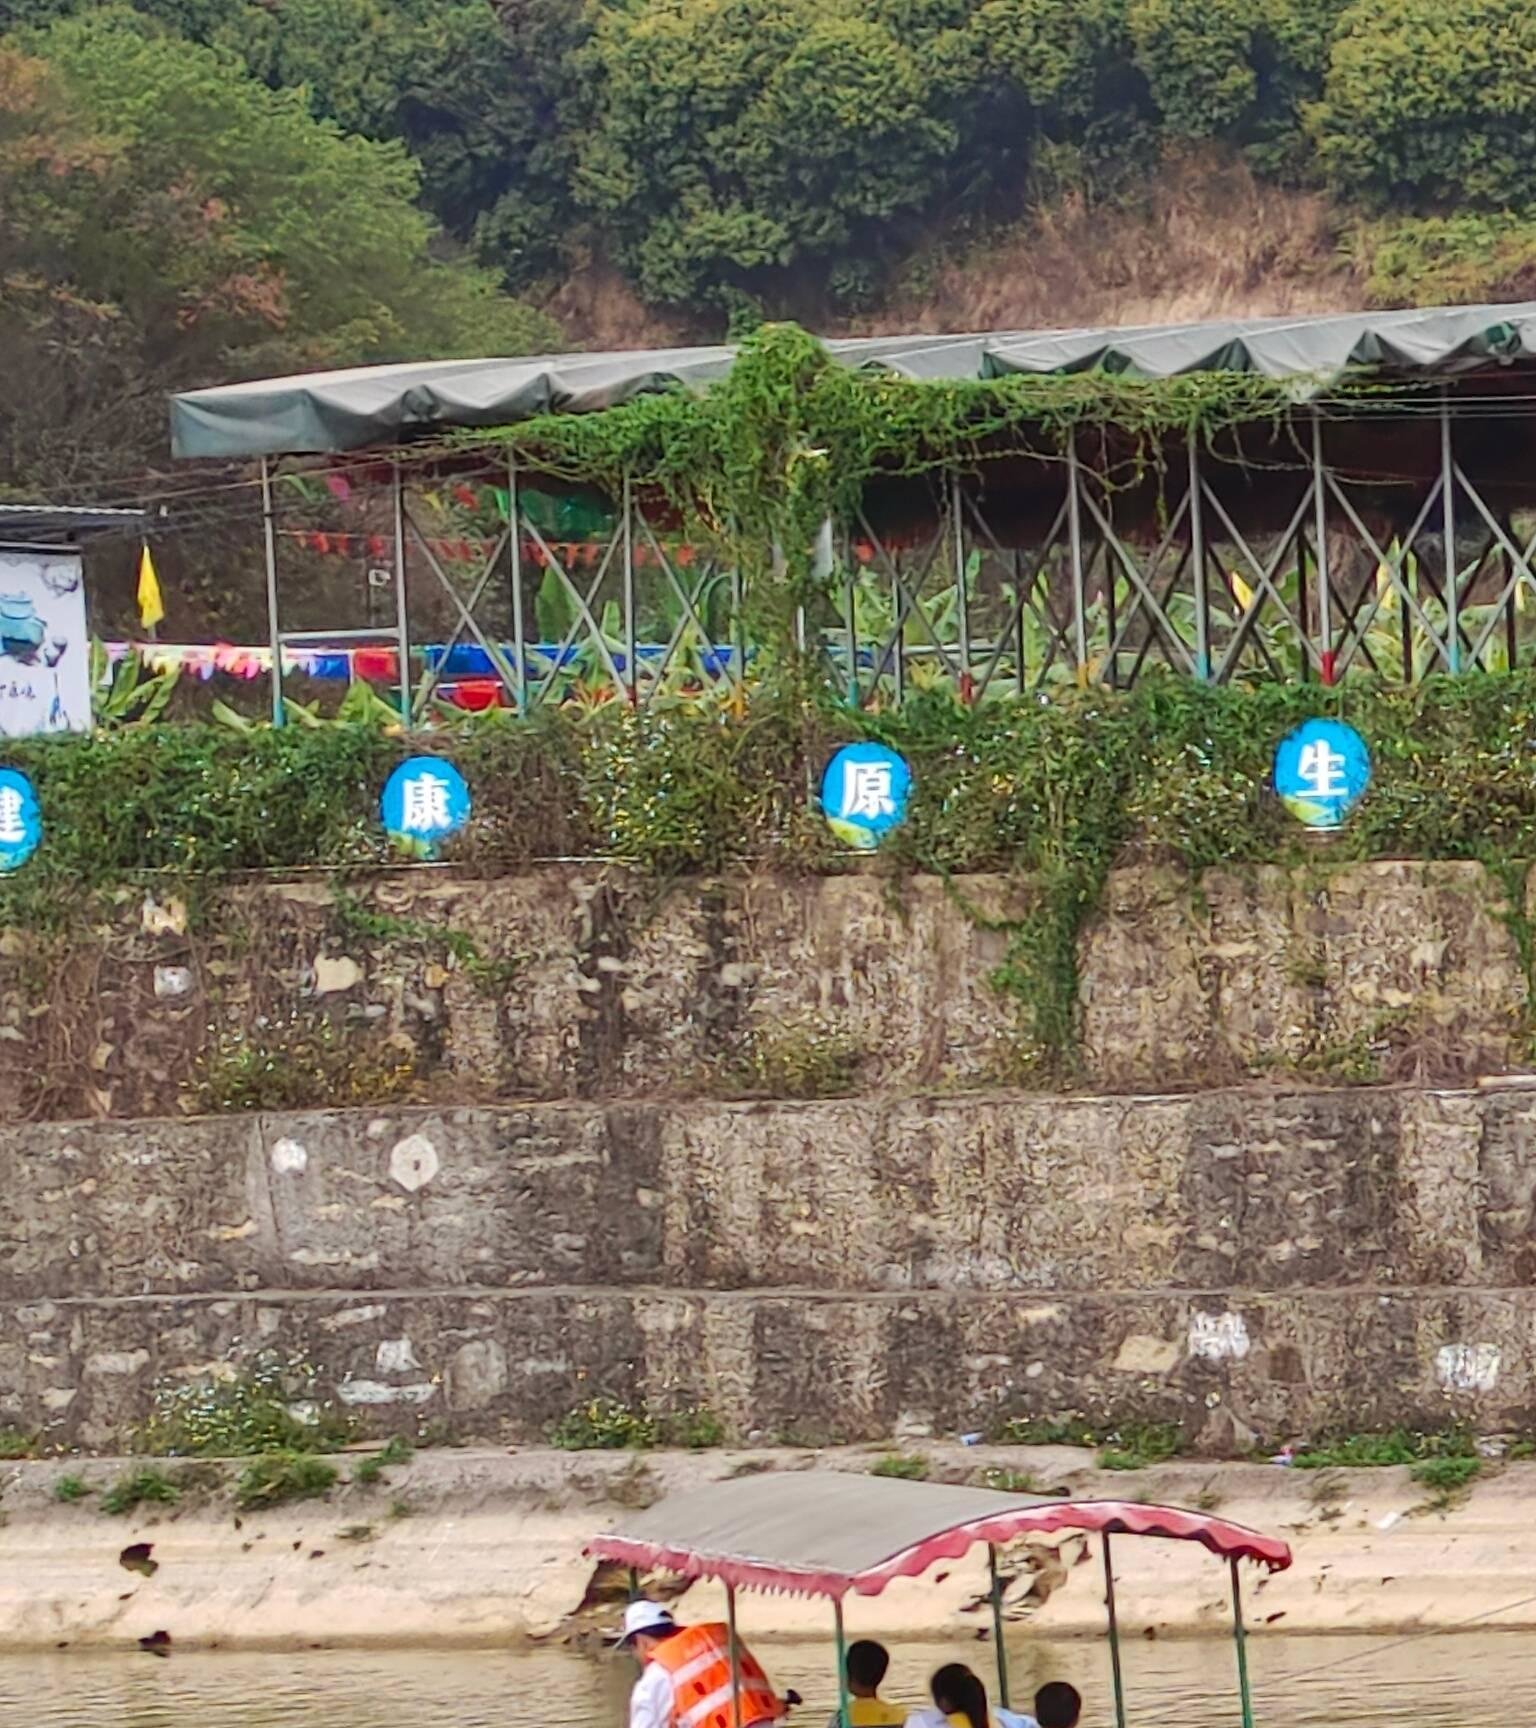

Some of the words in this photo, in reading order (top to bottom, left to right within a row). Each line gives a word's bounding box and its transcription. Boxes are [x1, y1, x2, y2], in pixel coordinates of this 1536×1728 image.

[842, 762, 894, 818] 原
[1296, 739, 1348, 797] 生
[403, 774, 451, 831] 康
